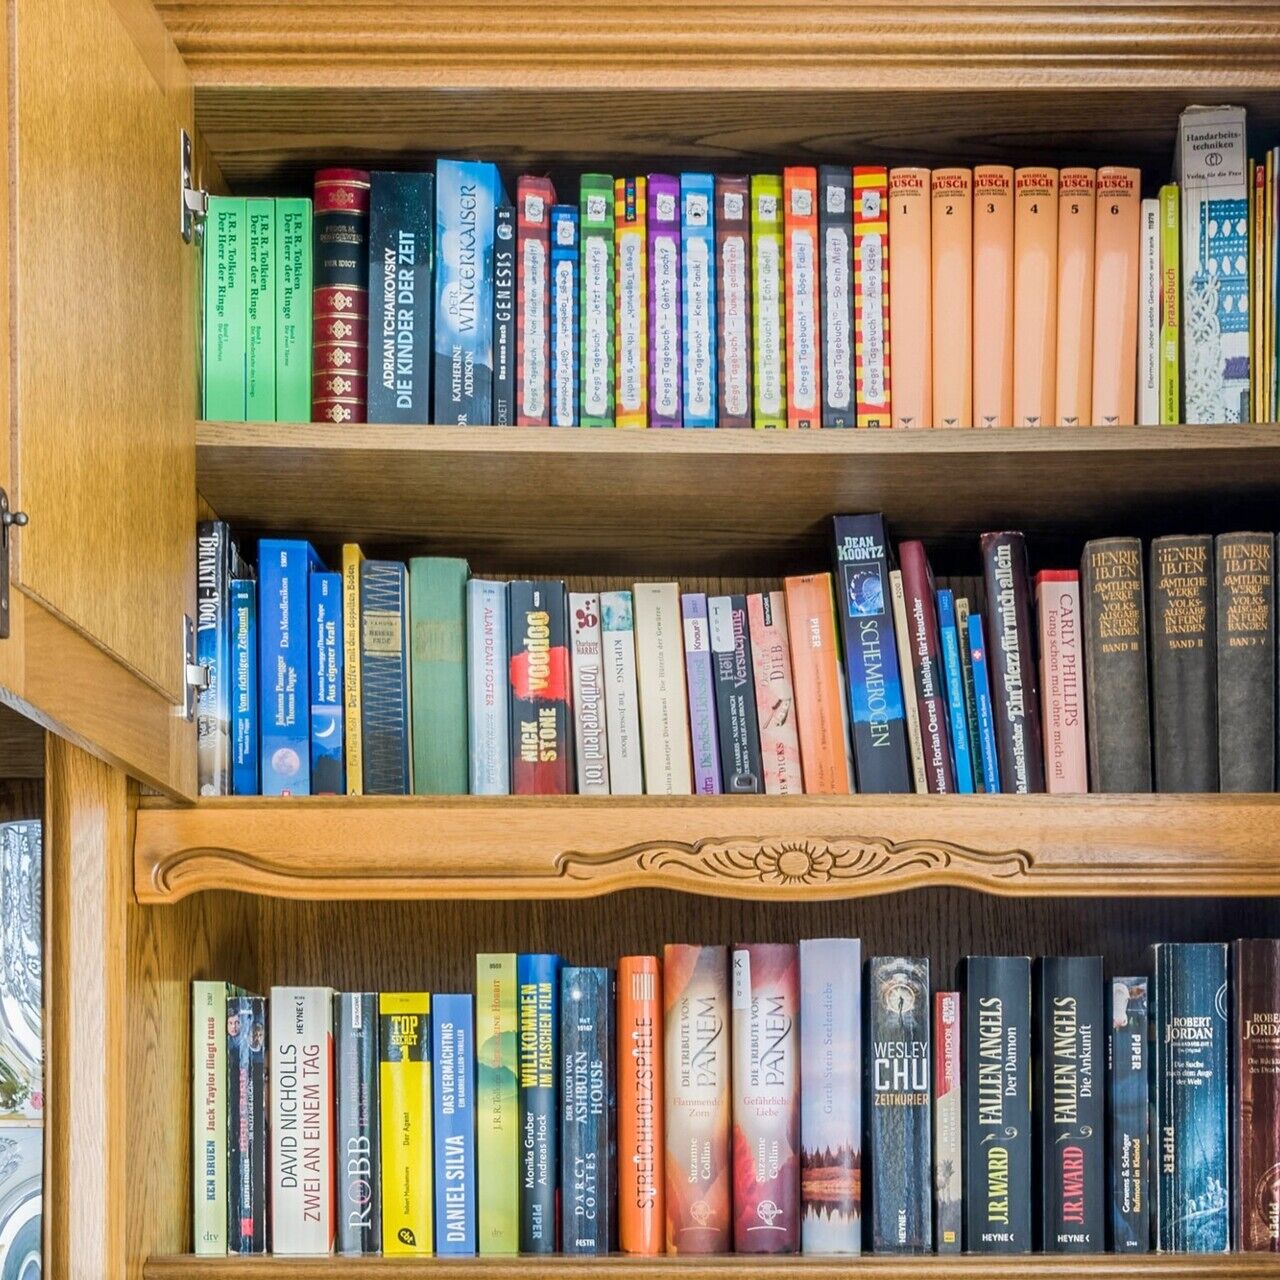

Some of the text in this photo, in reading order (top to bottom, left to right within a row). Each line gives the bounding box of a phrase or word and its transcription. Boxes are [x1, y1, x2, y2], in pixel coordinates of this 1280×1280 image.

[1186, 128, 1241, 141] Handarbeits-
[1192, 141, 1233, 151] techniken
[932, 180, 967, 189] BUSCH
[1017, 179, 1053, 187] BUSCH
[218, 212, 227, 227] Der
[945, 205, 953, 215] 2
[1030, 204, 1038, 213] 4
[218, 230, 227, 259] Herr
[227, 244, 237, 288] Tolkien
[459, 184, 476, 332] WINTERKAISER
[218, 265, 227, 282] der
[496, 252, 512, 321] GENESIS
[215, 286, 227, 318] Ringe
[383, 248, 396, 389] ADRIAN TCHAIKOVSKY
[396, 230, 415, 408] DIE KINDER DER ZEIT
[449, 291, 458, 315] DER
[1167, 268, 1176, 328] praxisbuch
[452, 344, 461, 401] KATHERINE
[464, 351, 473, 397] ADDISON
[838, 545, 884, 561] KOONTZ
[844, 537, 874, 549] DEAN
[280, 577, 288, 648] Das Mondlexikon
[914, 597, 926, 640] Heuchler
[326, 622, 337, 702] Aus eigener Kraft
[614, 639, 625, 683] KIPLING
[922, 656, 934, 698] Halleluja
[1060, 593, 1078, 727] CARLY PHILLIPS
[539, 707, 557, 762] STONE
[928, 700, 938, 732] Oertel
[521, 721, 538, 762] NICK
[932, 734, 942, 764] Florian
[391, 1016, 418, 1034] TOP
[391, 1035, 418, 1046] SECRET
[521, 984, 537, 1088] WILLKOMMEN
[539, 983, 552, 1088] IM FALSCHEN FILM
[692, 996, 723, 1086] PANEM
[760, 995, 792, 1086] PANEM
[441, 1023, 454, 1114] DAS VERMÄCHTNIS
[874, 1042, 928, 1058] WESLEY
[979, 997, 1002, 1124] FALLEN ANGELS
[1054, 997, 1077, 1123] FALLEN ANGELS
[1079, 1024, 1092, 1098] Die Ankunft
[1131, 1035, 1141, 1070] PIPER
[575, 1051, 588, 1124] ASHBURN
[590, 1060, 603, 1114] HOUSE
[875, 1058, 927, 1091] CHU
[1005, 1077, 1017, 1096] Der
[280, 1044, 297, 1188] DAVID NICHOLLS
[635, 1017, 654, 1209] STREICHHOLZSPIELE
[874, 1093, 928, 1106] ZEITKURIER
[303, 1044, 320, 1221] ZWEI AN EINEM TAG
[525, 1112, 534, 1188] Monika Gruber
[537, 1114, 547, 1186] Andreas Hock
[206, 1140, 216, 1201] KEN BRUEN
[688, 1138, 698, 1183] Suzanne
[701, 1138, 710, 1179] Collins
[988, 1147, 1008, 1195] WARD
[347, 1136, 372, 1230] ROBB
[445, 1135, 466, 1243] DANIEL SILVA
[575, 1158, 584, 1216] DARCY
[585, 1152, 596, 1220] COATES
[533, 1204, 542, 1239] PIPER
[982, 1233, 1009, 1242] HEYNE
